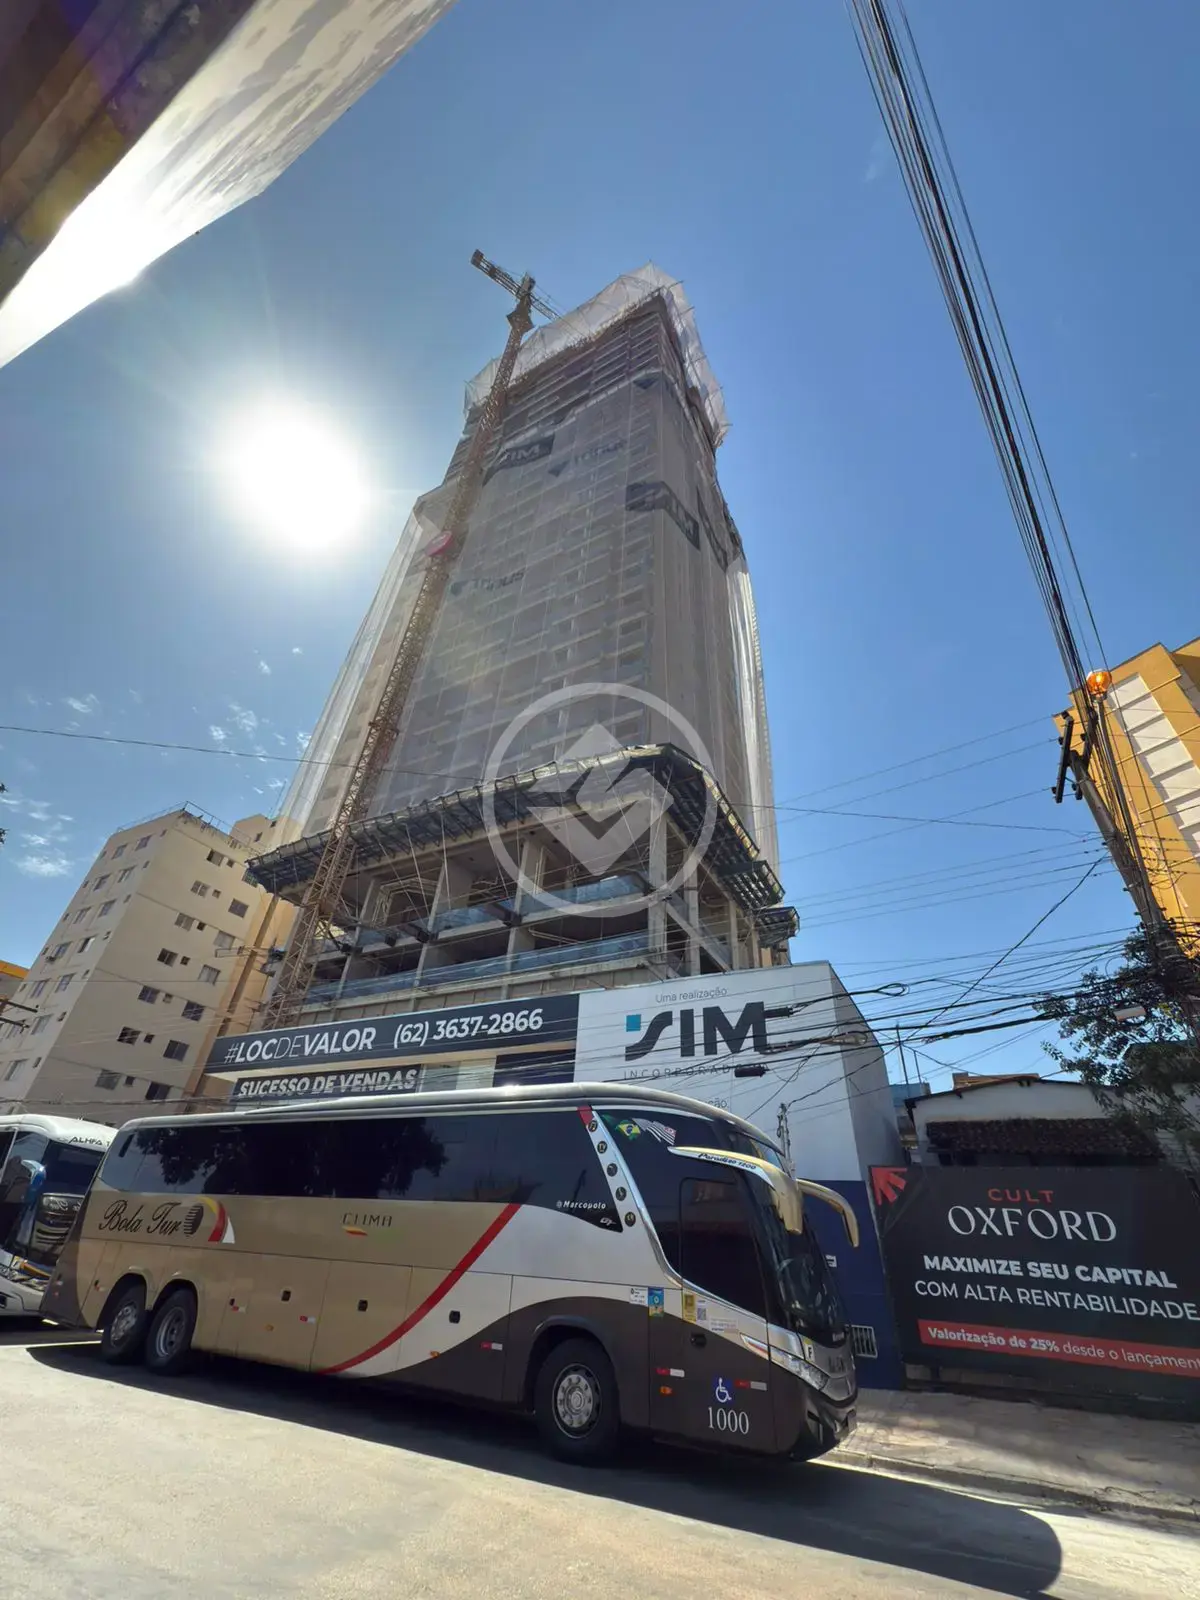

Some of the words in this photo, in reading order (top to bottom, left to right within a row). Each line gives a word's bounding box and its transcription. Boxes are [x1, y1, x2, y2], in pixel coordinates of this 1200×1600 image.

[655, 993, 677, 1003] Uma
[679, 987, 728, 1000] realização
[224, 1027, 377, 1064] #LOCDEVALOR
[394, 1020, 430, 1049] (62)
[432, 1008, 544, 1042] 3637-2866
[625, 1001, 767, 1062] SIM
[238, 1077, 309, 1098] SUCESSO
[312, 1075, 338, 1095] DE
[339, 1069, 418, 1093] VENDAS
[563, 1200, 607, 1210] Marcopolo
[987, 1188, 1054, 1204] CULT
[98, 1199, 144, 1232] Bola
[146, 1201, 182, 1236] Tur
[947, 1204, 1117, 1242] OXFORD
[924, 1254, 1024, 1277] MAXIMIZE
[1027, 1261, 1070, 1280] SEU
[1075, 1264, 1178, 1289] CAPITAL
[915, 1280, 959, 1299] COM
[964, 1283, 1013, 1304] ALTA
[1016, 1287, 1200, 1322] RENTABILIDADE
[928, 1327, 1006, 1347] Valorização
[1009, 1335, 1027, 1349] de
[1029, 1337, 1060, 1354] 25%
[1063, 1342, 1105, 1359] desde
[1109, 1350, 1119, 1360] o
[707, 1406, 750, 1435] 1000
